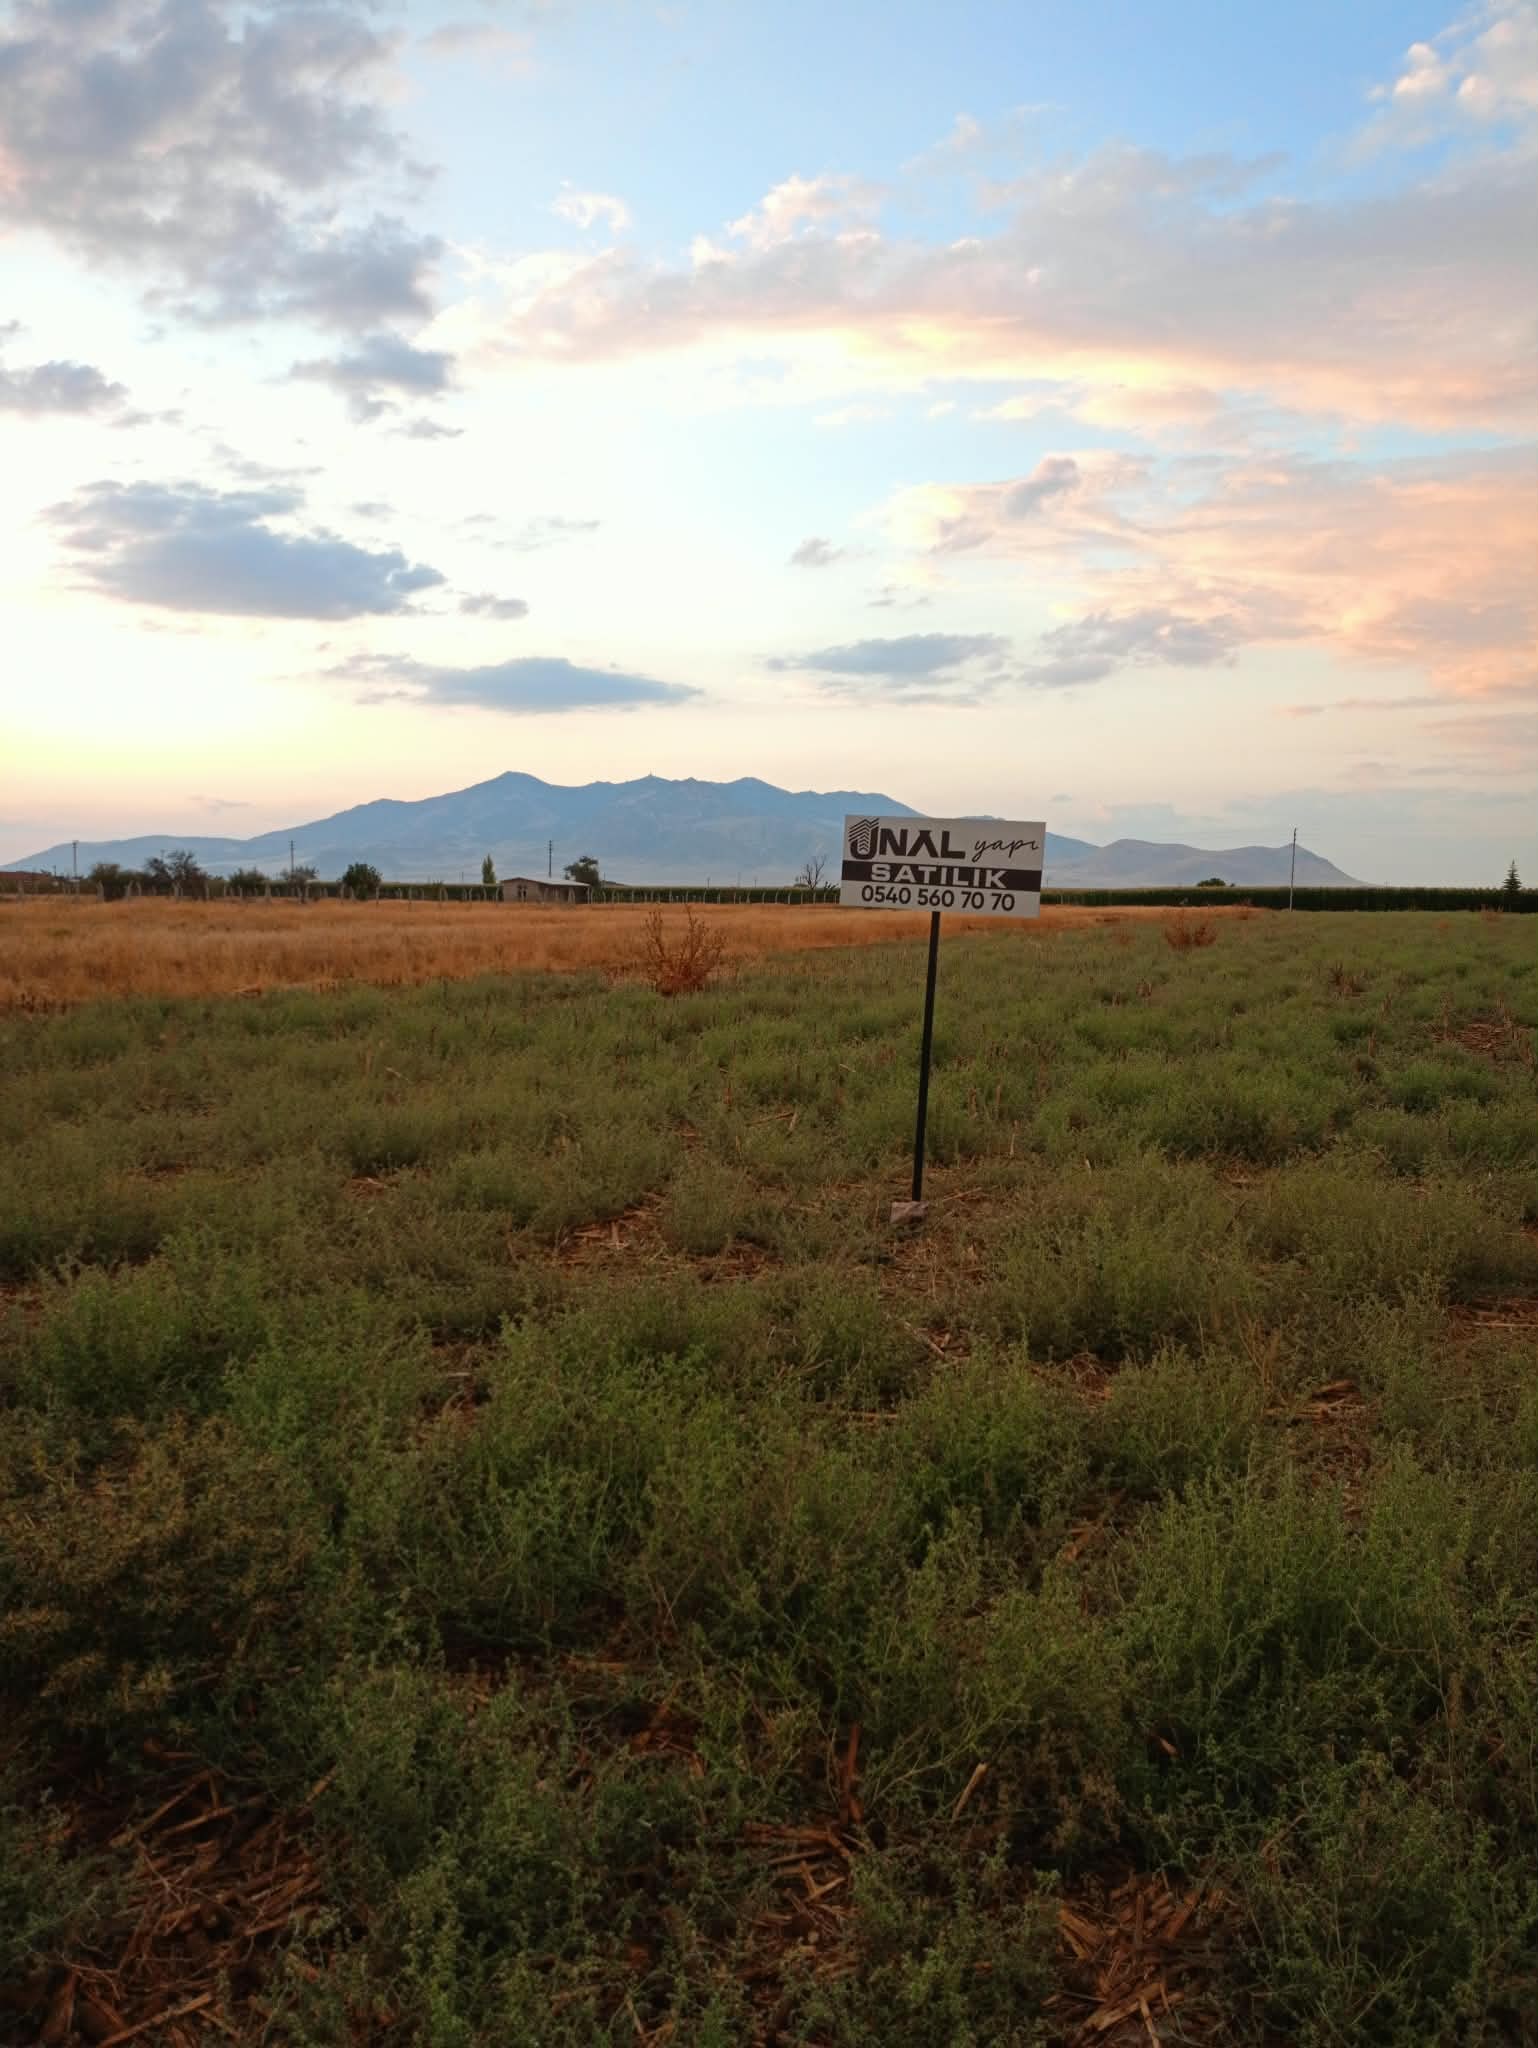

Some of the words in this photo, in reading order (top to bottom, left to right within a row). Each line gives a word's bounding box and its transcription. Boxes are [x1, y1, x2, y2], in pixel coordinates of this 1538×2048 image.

[870, 863, 1007, 889] SATILIK
[861, 885, 912, 904] 0540
[917, 889, 955, 908] 560
[960, 891, 985, 910] 70
[991, 893, 1015, 912] 70
